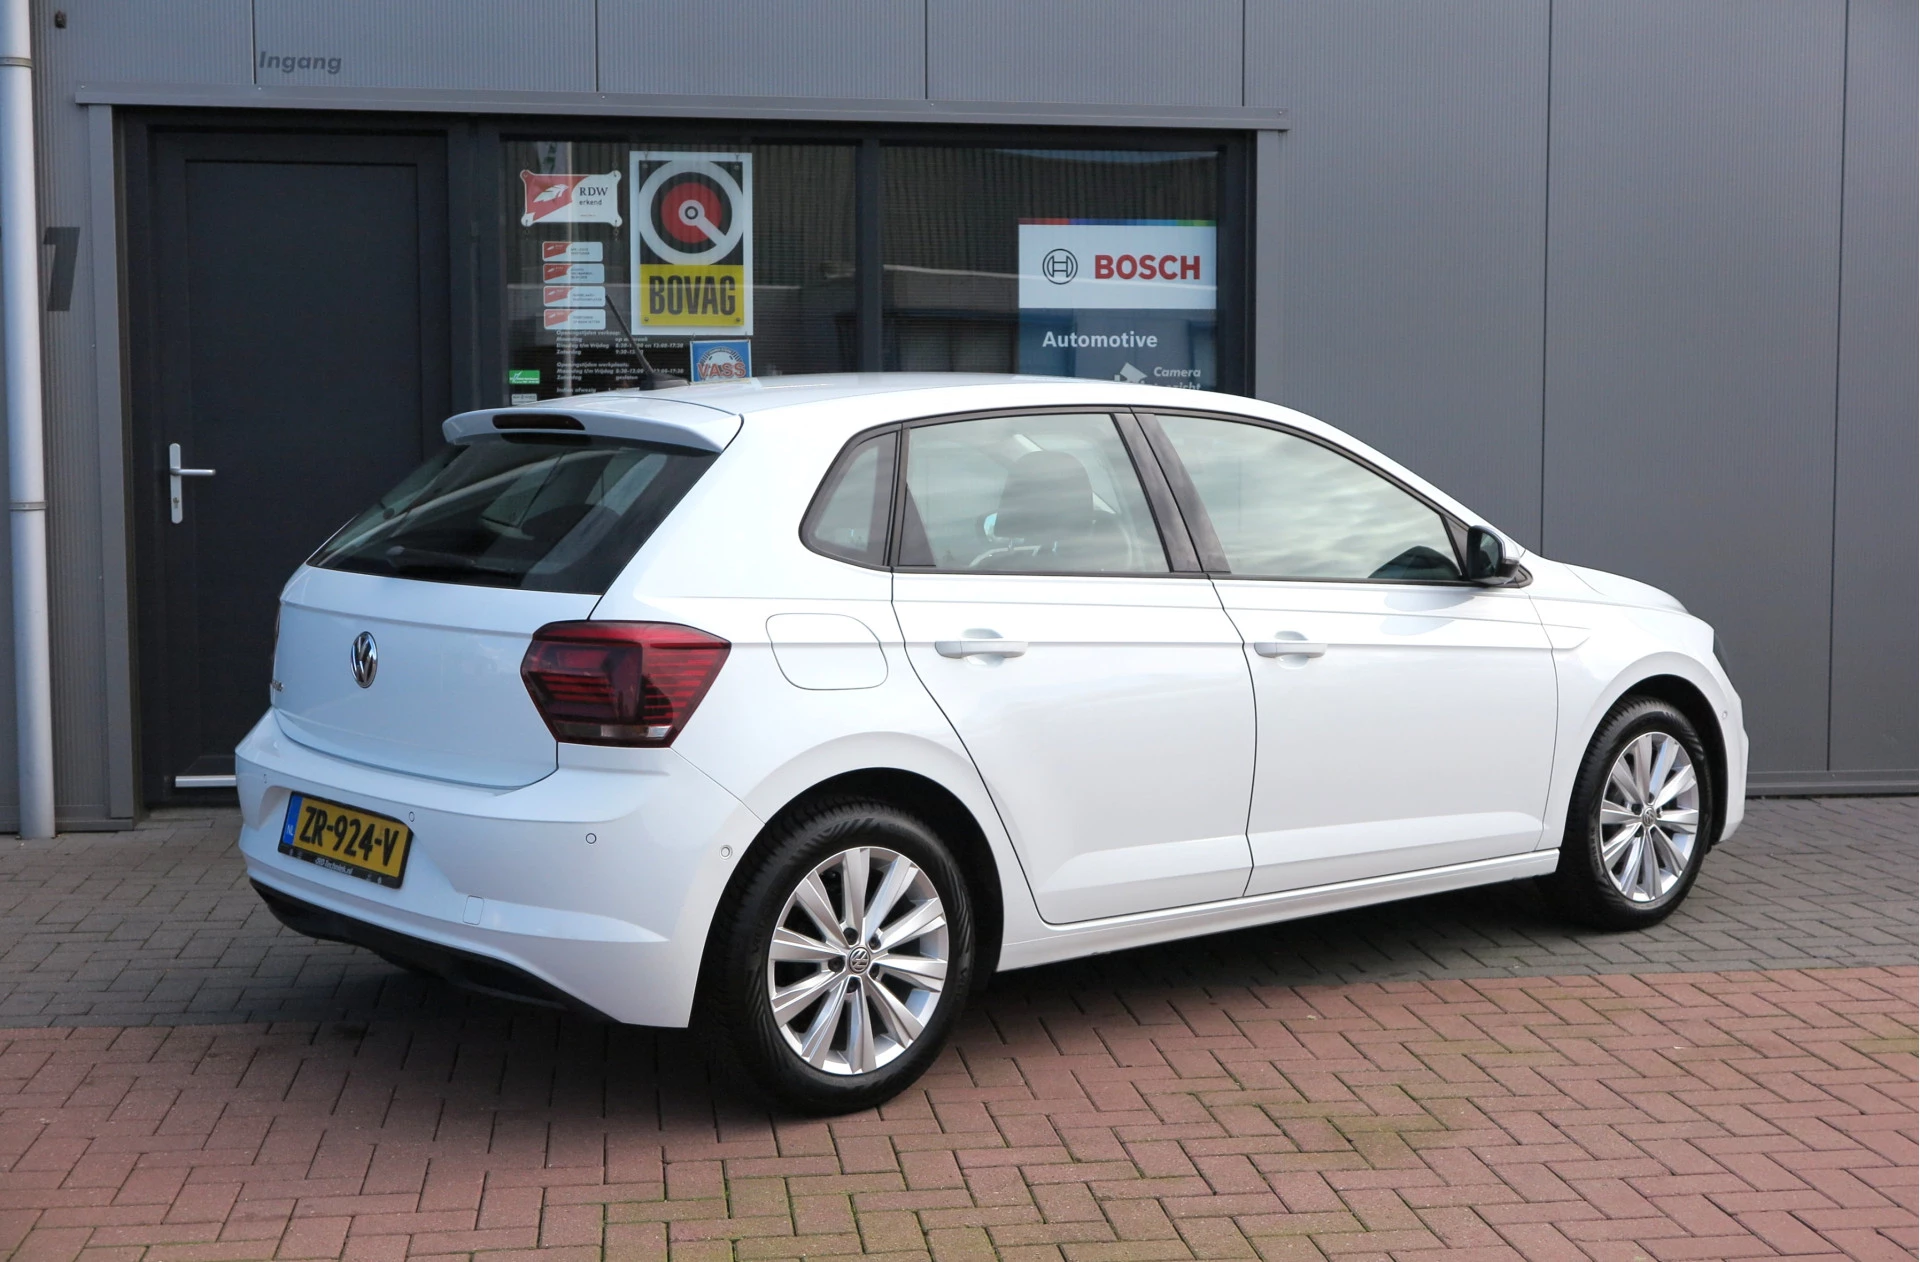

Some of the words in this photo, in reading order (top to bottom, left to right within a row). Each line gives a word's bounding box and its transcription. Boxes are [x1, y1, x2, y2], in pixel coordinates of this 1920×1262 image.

[259, 51, 342, 74] Ingang
[579, 186, 609, 196] RDW
[1094, 254, 1200, 280] BOSCH
[649, 275, 736, 316] BOVAG
[1042, 331, 1158, 348] Automotive
[696, 361, 746, 379] VASS
[1153, 366, 1201, 378] Camera
[299, 806, 399, 867] ZR-924-V
